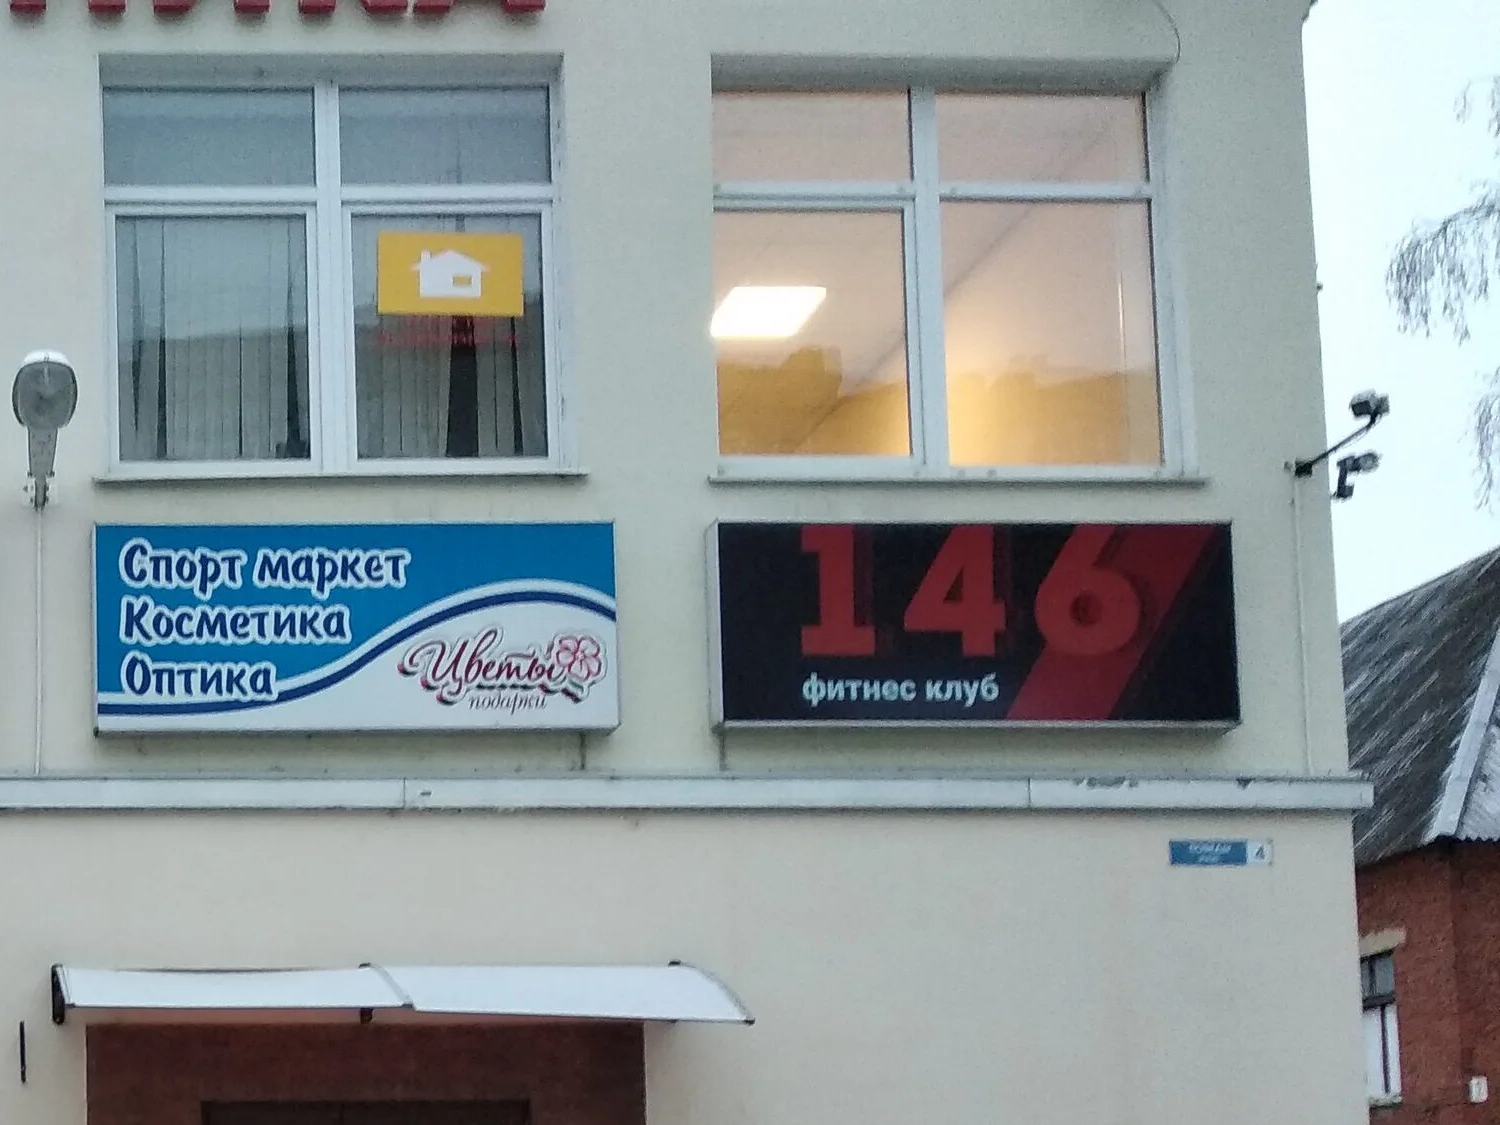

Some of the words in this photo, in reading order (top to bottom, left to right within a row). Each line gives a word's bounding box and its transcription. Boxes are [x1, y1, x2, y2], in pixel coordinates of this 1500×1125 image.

[120, 539, 248, 598] Спорт
[252, 548, 411, 599] маркет
[119, 595, 353, 645] Косметика
[120, 651, 278, 700] Оптика
[802, 673, 916, 707] фитнес
[925, 676, 999, 706] клуб
